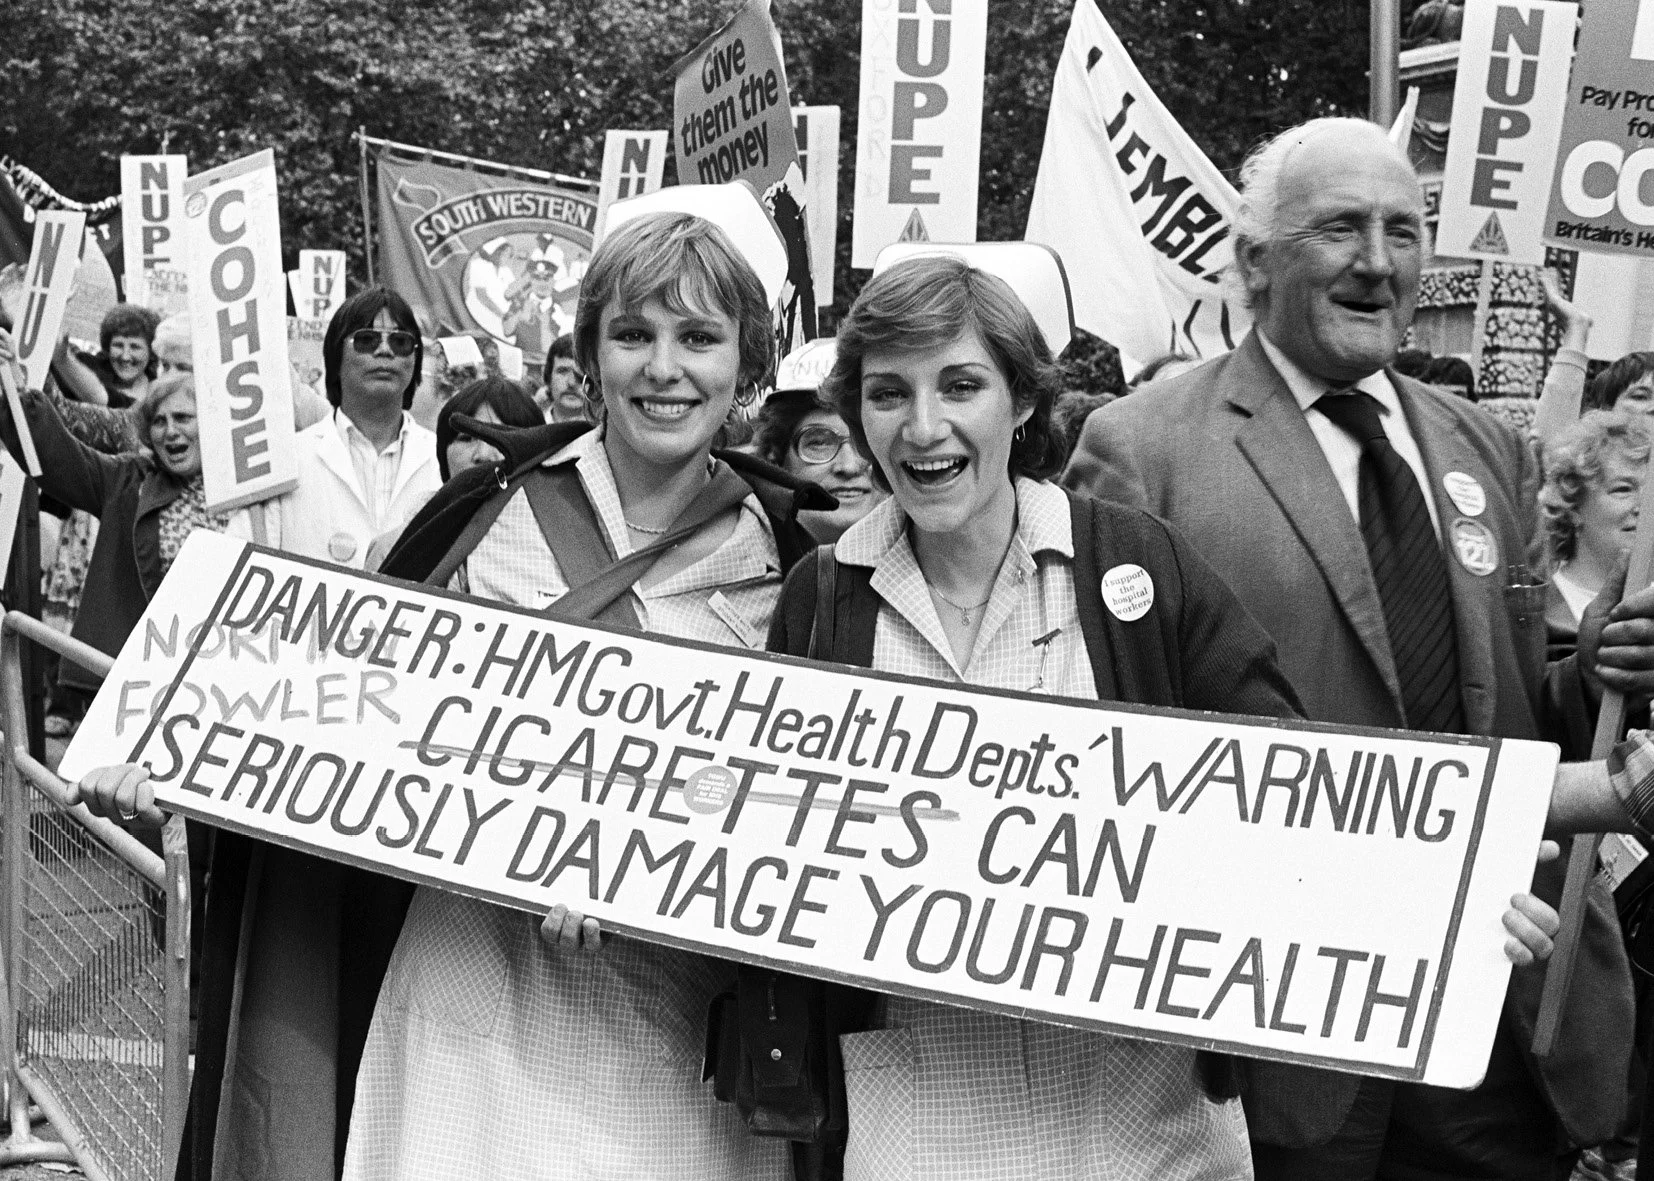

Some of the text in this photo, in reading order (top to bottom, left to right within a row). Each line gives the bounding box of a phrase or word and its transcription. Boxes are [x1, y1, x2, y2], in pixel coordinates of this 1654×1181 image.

[701, 37, 746, 94] Give
[681, 96, 737, 158] them
[739, 68, 778, 121] the
[888, 0, 952, 204] UPE
[1469, 5, 1545, 210] NUPE
[1579, 86, 1621, 111] Pay
[697, 121, 769, 185] money
[419, 193, 591, 246] SOUTH WESTERN
[1555, 221, 1633, 247] Britain's
[208, 189, 272, 485] COHSE
[1110, 569, 1144, 586] support
[1112, 586, 1148, 606] hospital
[1115, 598, 1152, 615] workers
[1119, 585, 1135, 594] the
[116, 670, 401, 737] FOWLER
[472, 623, 591, 708] HM
[714, 670, 911, 773] Health
[1111, 727, 1470, 843] WARNING
[416, 696, 1157, 904] CIGARETTES CAN
[142, 713, 1429, 1049] SERIOUSLY DAMAGE YOUR HEALTH
